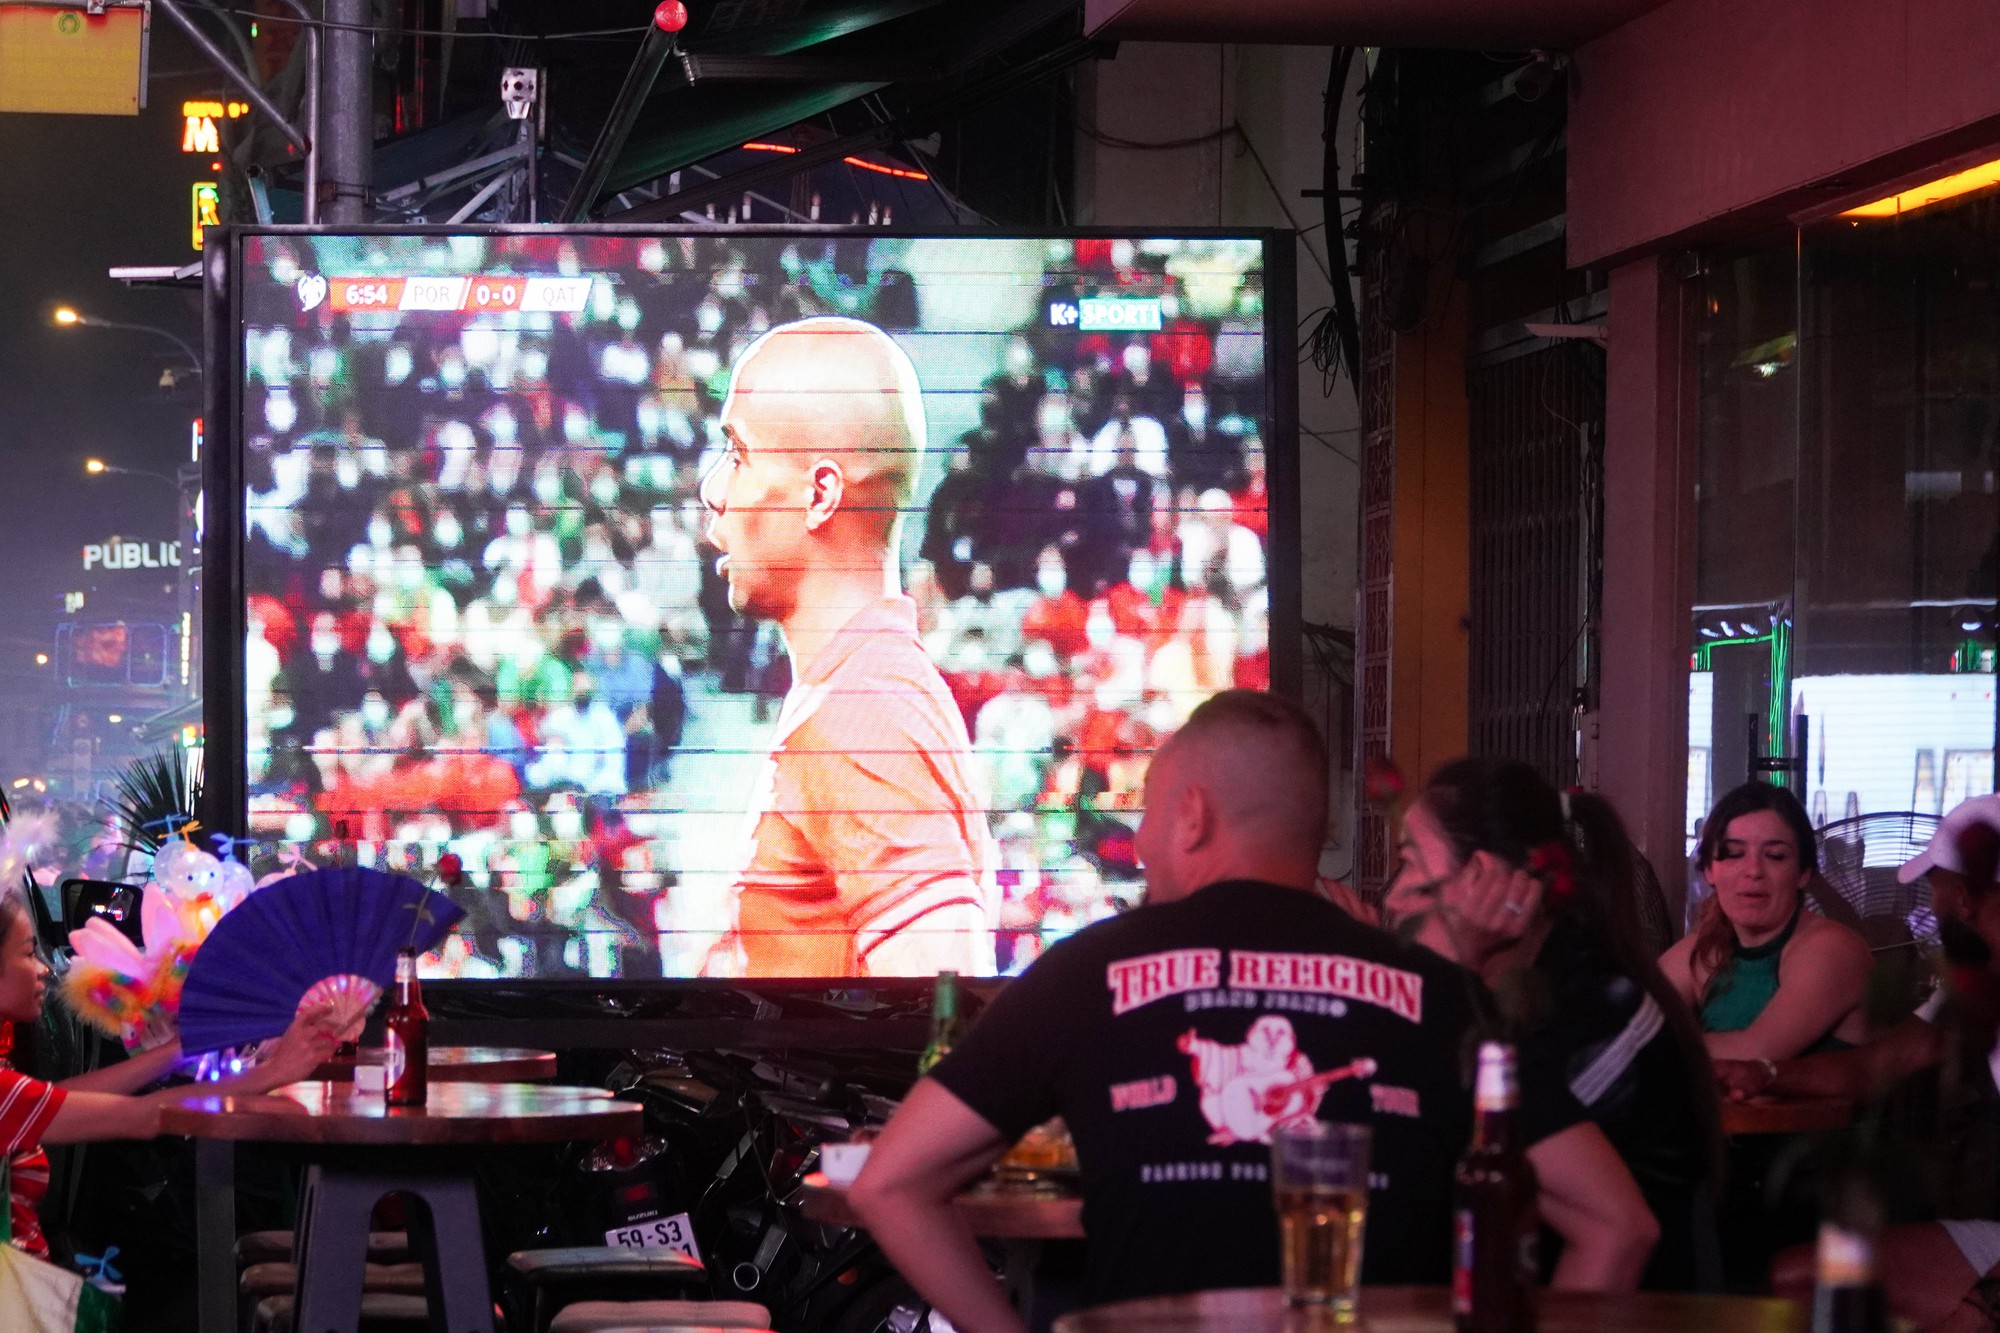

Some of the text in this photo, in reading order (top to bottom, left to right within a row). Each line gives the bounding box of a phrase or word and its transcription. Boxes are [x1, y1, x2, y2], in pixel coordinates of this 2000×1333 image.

[346, 285, 388, 305] 6:54
[413, 285, 449, 303] POR
[477, 285, 516, 305] 0-0
[542, 286, 576, 306] QAT
[1050, 303, 1078, 325] K+
[83, 541, 181, 570] PUBLIC
[1107, 948, 1423, 1024] TRUE RELIGION
[616, 1221, 682, 1248] 59-S3
